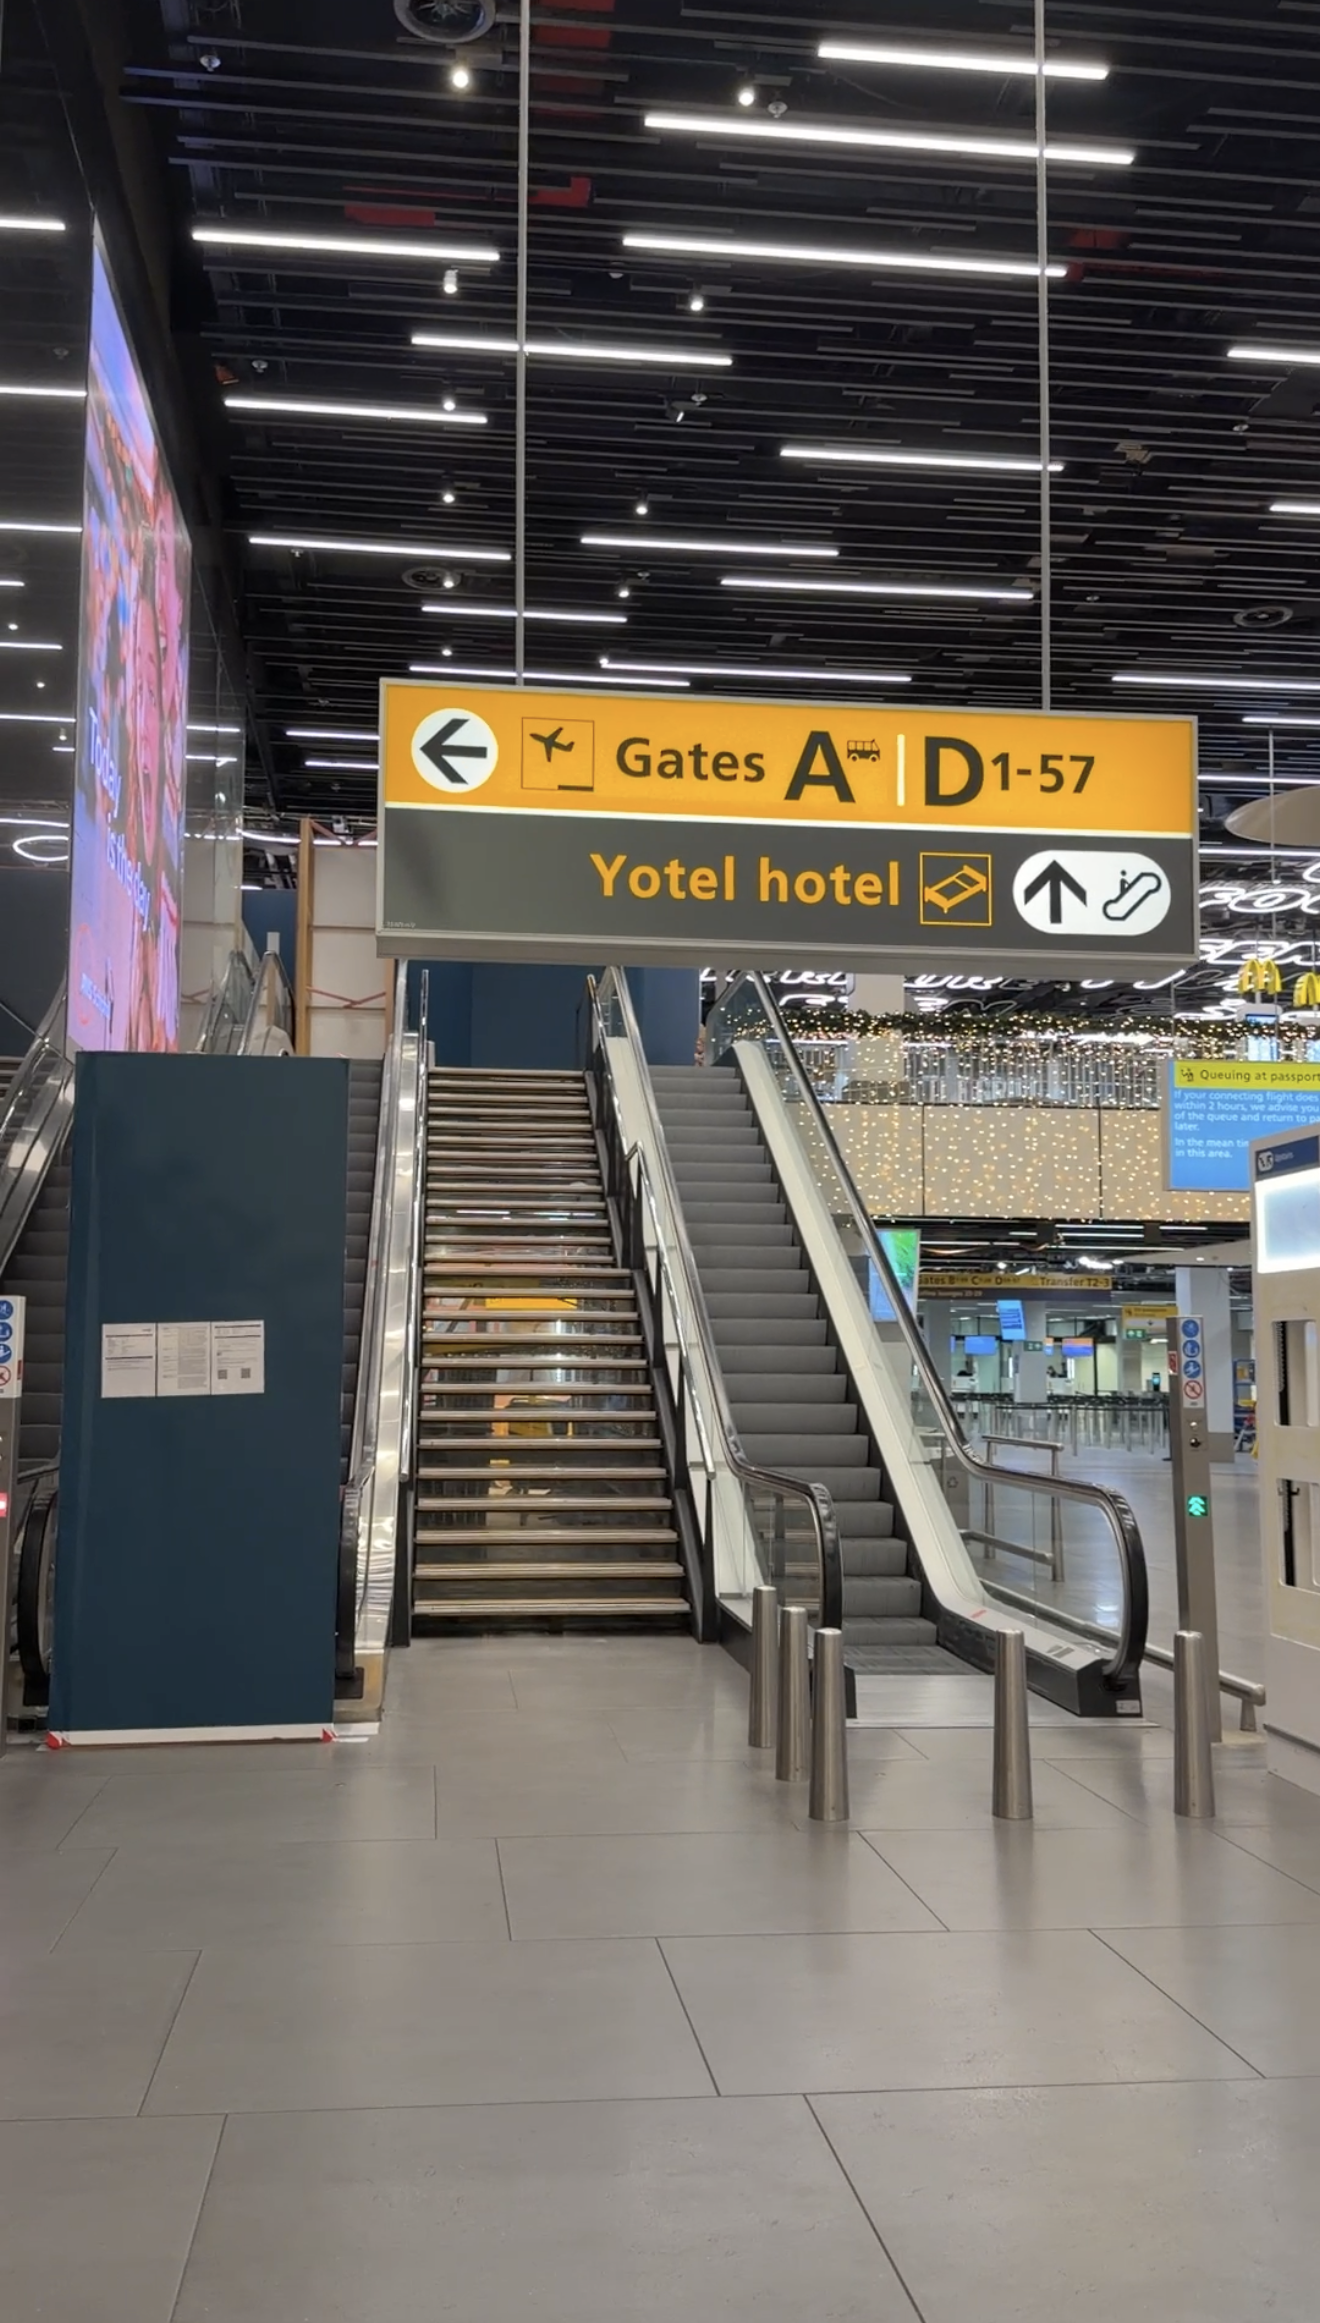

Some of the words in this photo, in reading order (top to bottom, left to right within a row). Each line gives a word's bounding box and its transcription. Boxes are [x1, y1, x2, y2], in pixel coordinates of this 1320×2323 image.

[89, 707, 122, 818] Today
[615, 736, 766, 783] Gates
[784, 730, 856, 803] A
[589, 853, 736, 901] Yotel
[759, 856, 900, 906] hotel
[133, 862, 151, 931] day
[1200, 1069, 1251, 1083] Queuing
[1255, 1071, 1267, 1081] at
[1174, 1090, 1182, 1099] If
[1183, 1091, 1206, 1103] your
[1209, 1091, 1264, 1103] connecting
[1266, 1091, 1294, 1104] flight
[1295, 1092, 1319, 1102] does
[1174, 1101, 1206, 1110] within
[1208, 1101, 1215, 1110] 2
[1217, 1101, 1247, 1112] hours,
[1268, 1102, 1298, 1112] advise
[1300, 1104, 1320, 1114] you
[1174, 1111, 1185, 1120] of
[1187, 1112, 1205, 1121] the
[1207, 1113, 1238, 1122] queue
[1240, 1112, 1260, 1122] and
[1262, 1113, 1293, 1122] return
[1296, 1114, 1307, 1122] to
[1174, 1121, 1200, 1131] later.
[1174, 1137, 1185, 1146] In
[1187, 1137, 1204, 1147] the
[1206, 1139, 1234, 1148] mean
[1175, 1148, 1185, 1157] in
[1187, 1148, 1206, 1157] this
[1208, 1150, 1233, 1159] area.
[1040, 1276, 1085, 1287] Transfer
[1087, 1277, 1110, 1288] T2-3
